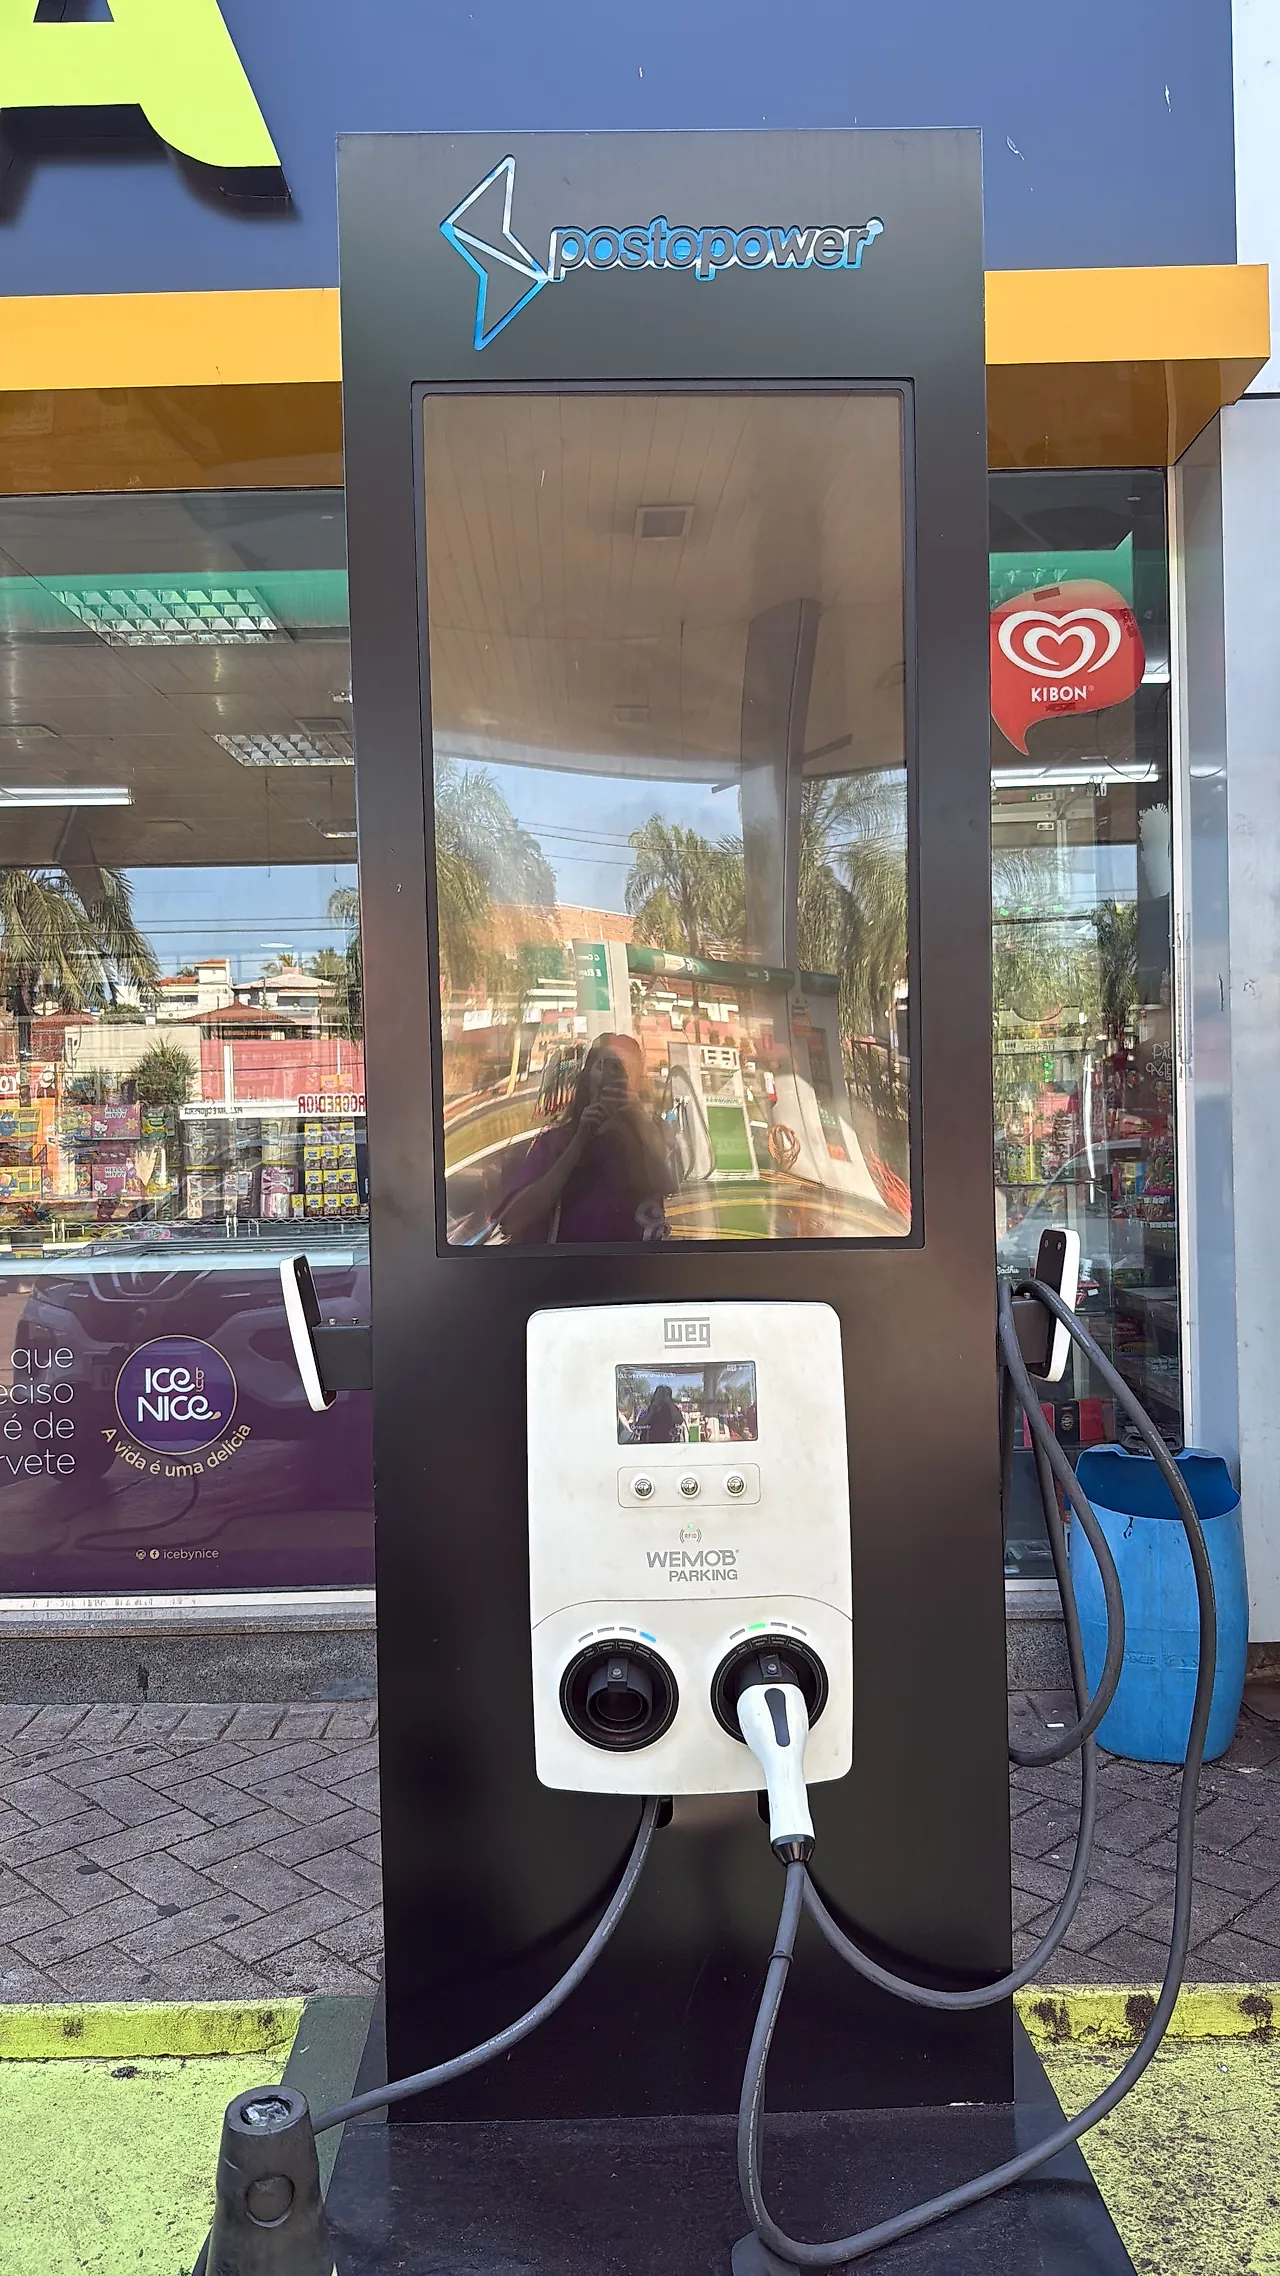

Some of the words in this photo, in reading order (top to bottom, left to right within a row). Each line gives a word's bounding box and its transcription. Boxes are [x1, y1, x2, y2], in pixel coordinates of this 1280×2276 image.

[552, 216, 884, 281] postopower
[1031, 686, 1088, 702] KIBON
[11, 1347, 74, 1375] que
[3, 1412, 23, 1441] é
[33, 1411, 75, 1440] de
[101, 1427, 117, 1443] A
[114, 1441, 147, 1470] vida
[149, 1460, 161, 1474] é
[165, 1462, 204, 1477] uma
[206, 1424, 252, 1468] delícia
[163, 1548, 220, 1561] icebynice
[646, 1549, 737, 1568] WEMOB
[669, 1569, 738, 1582] PARKING
